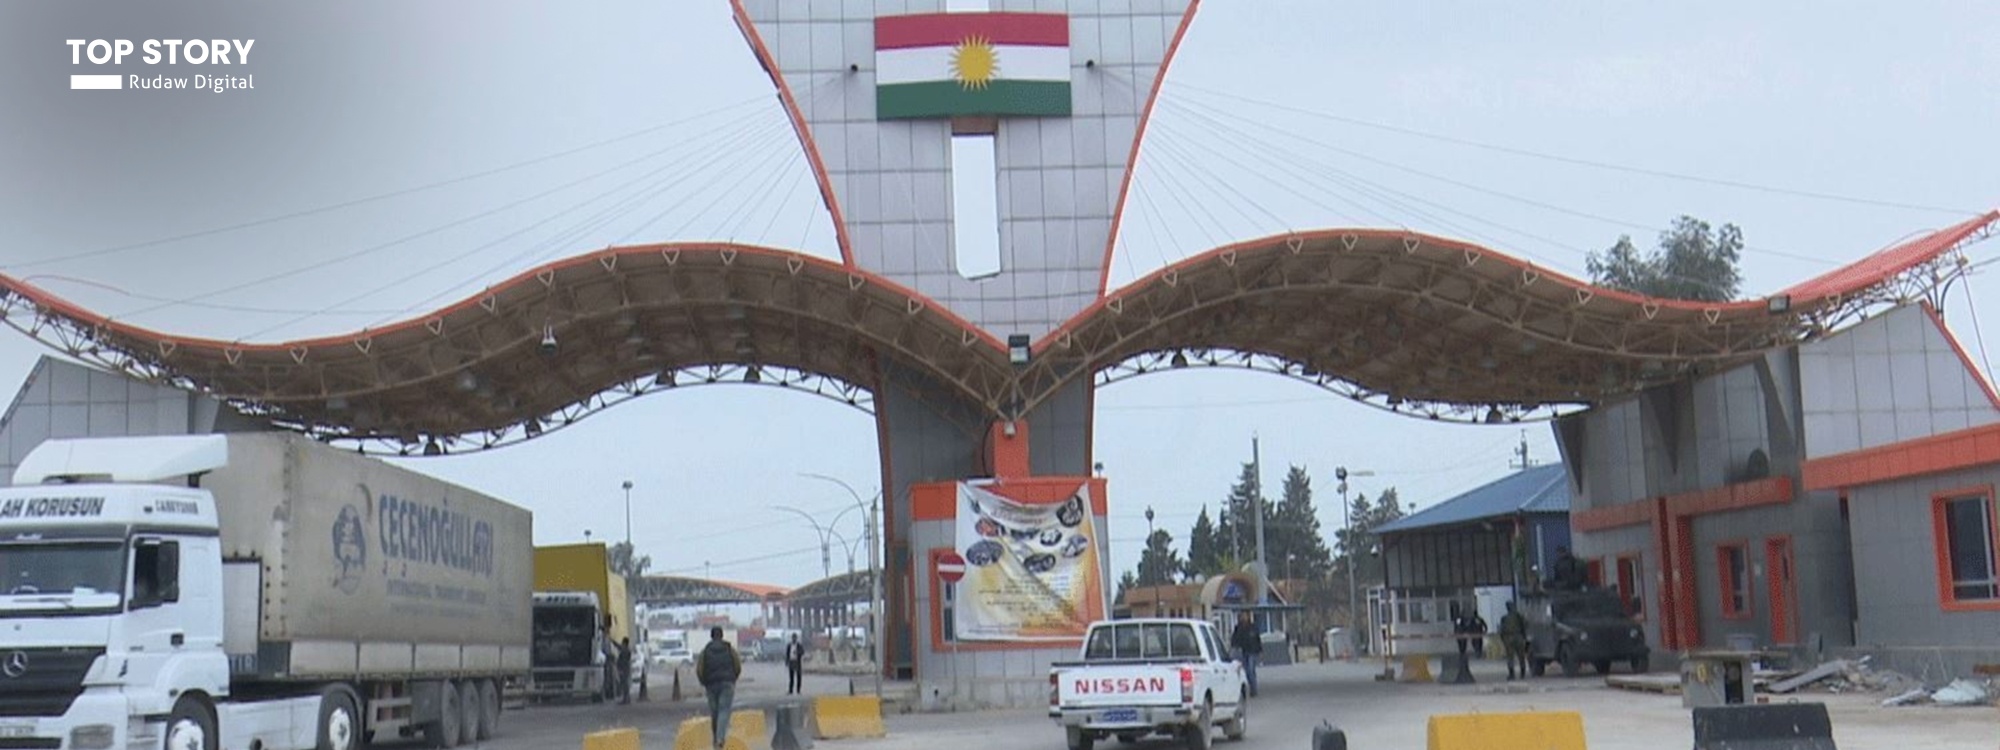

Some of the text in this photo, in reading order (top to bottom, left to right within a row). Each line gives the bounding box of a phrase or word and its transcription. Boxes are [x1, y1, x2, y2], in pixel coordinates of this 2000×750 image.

[0, 497, 105, 518] AH KORUSUN
[1075, 678, 1164, 694] NISSAN
